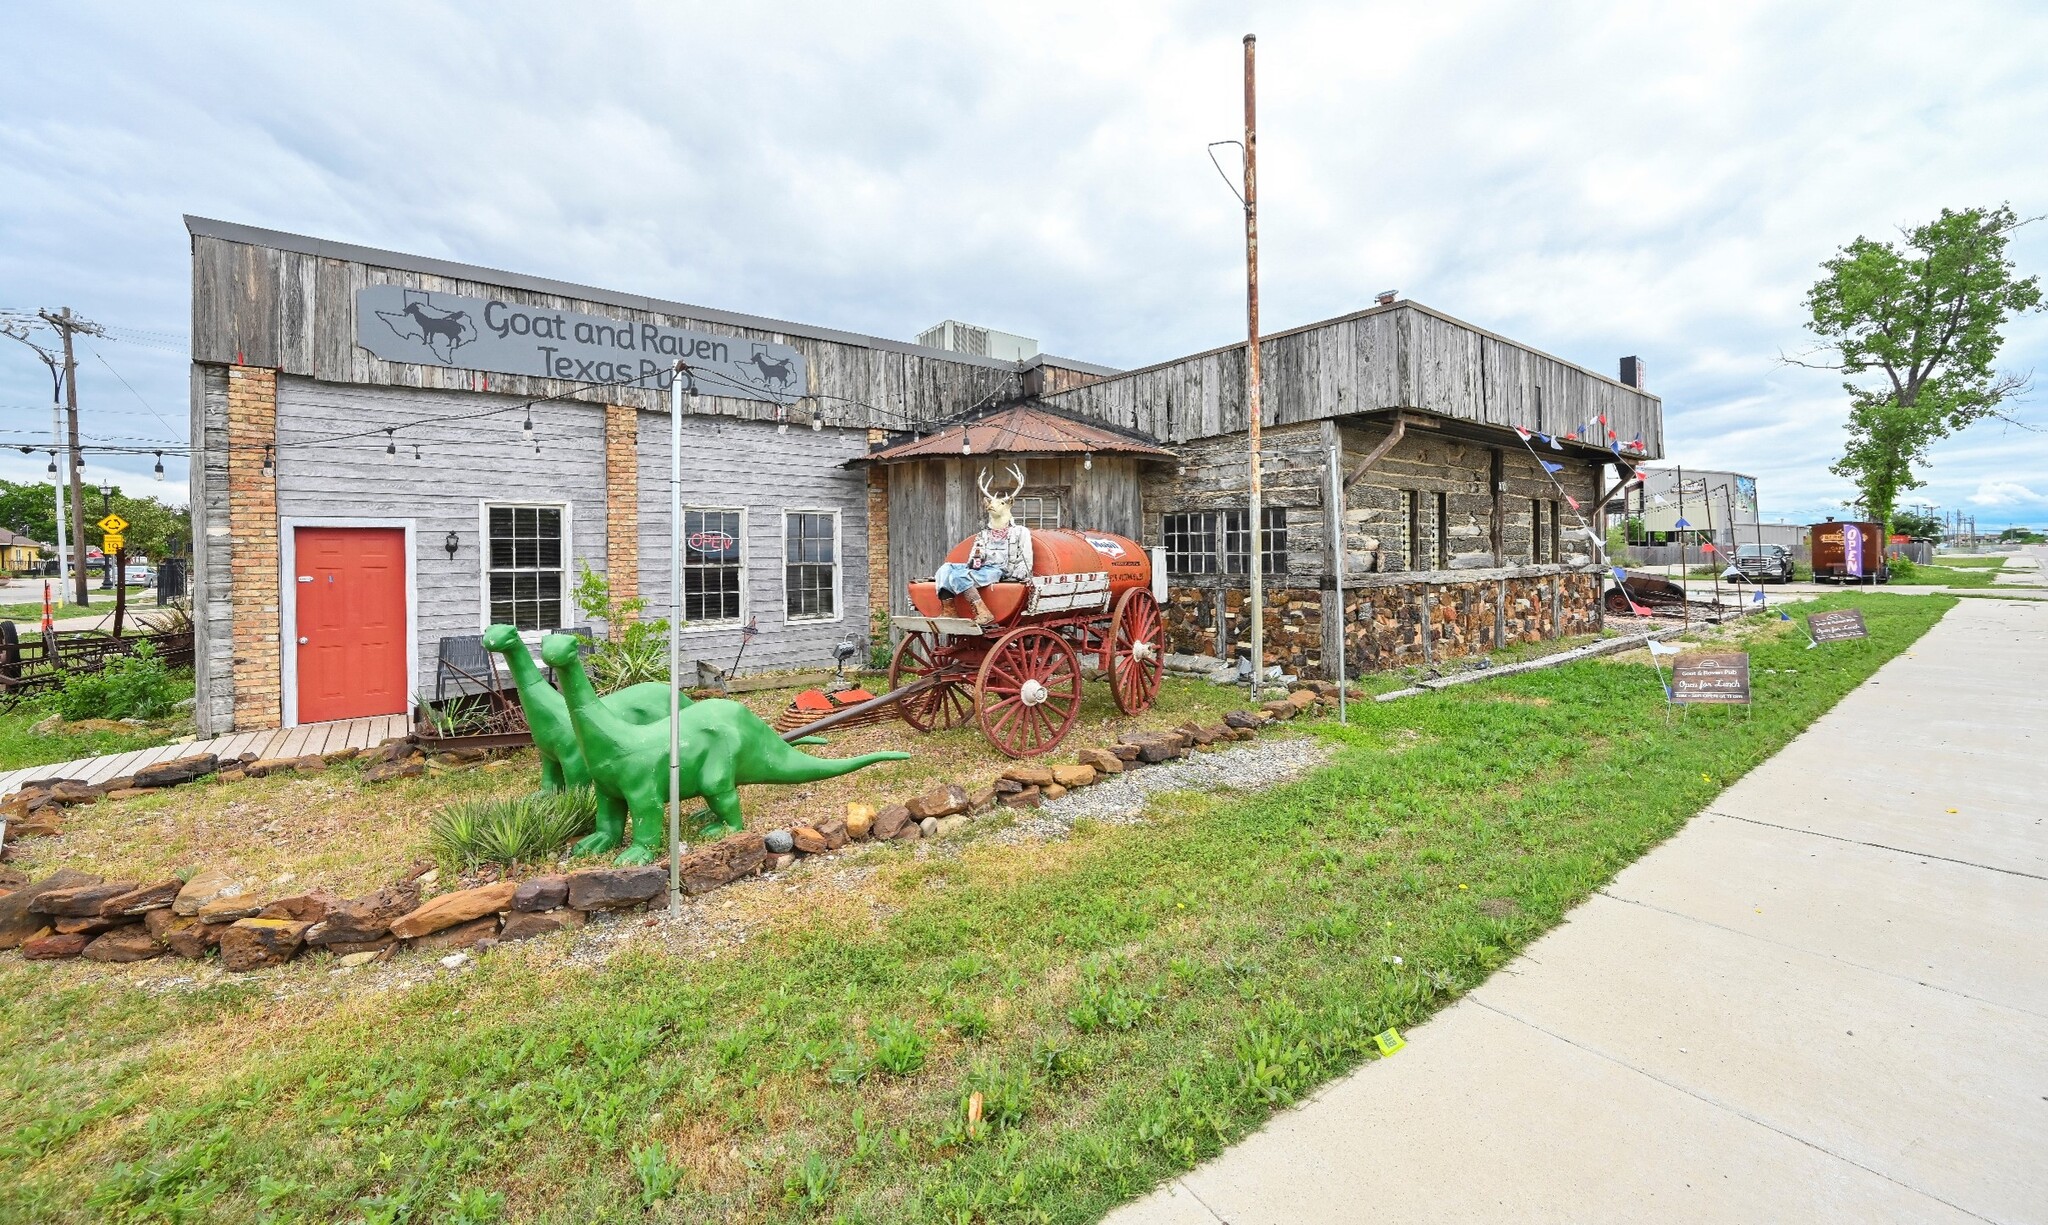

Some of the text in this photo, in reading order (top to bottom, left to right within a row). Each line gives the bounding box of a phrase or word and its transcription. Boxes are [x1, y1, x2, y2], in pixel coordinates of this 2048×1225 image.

[484, 301, 728, 363] Goat and Raven
[537, 346, 694, 391] Texas Pub
[691, 533, 731, 549] OPEN
[1847, 529, 1858, 572] OPEN
[1679, 679, 1740, 690] Open for Lunch
